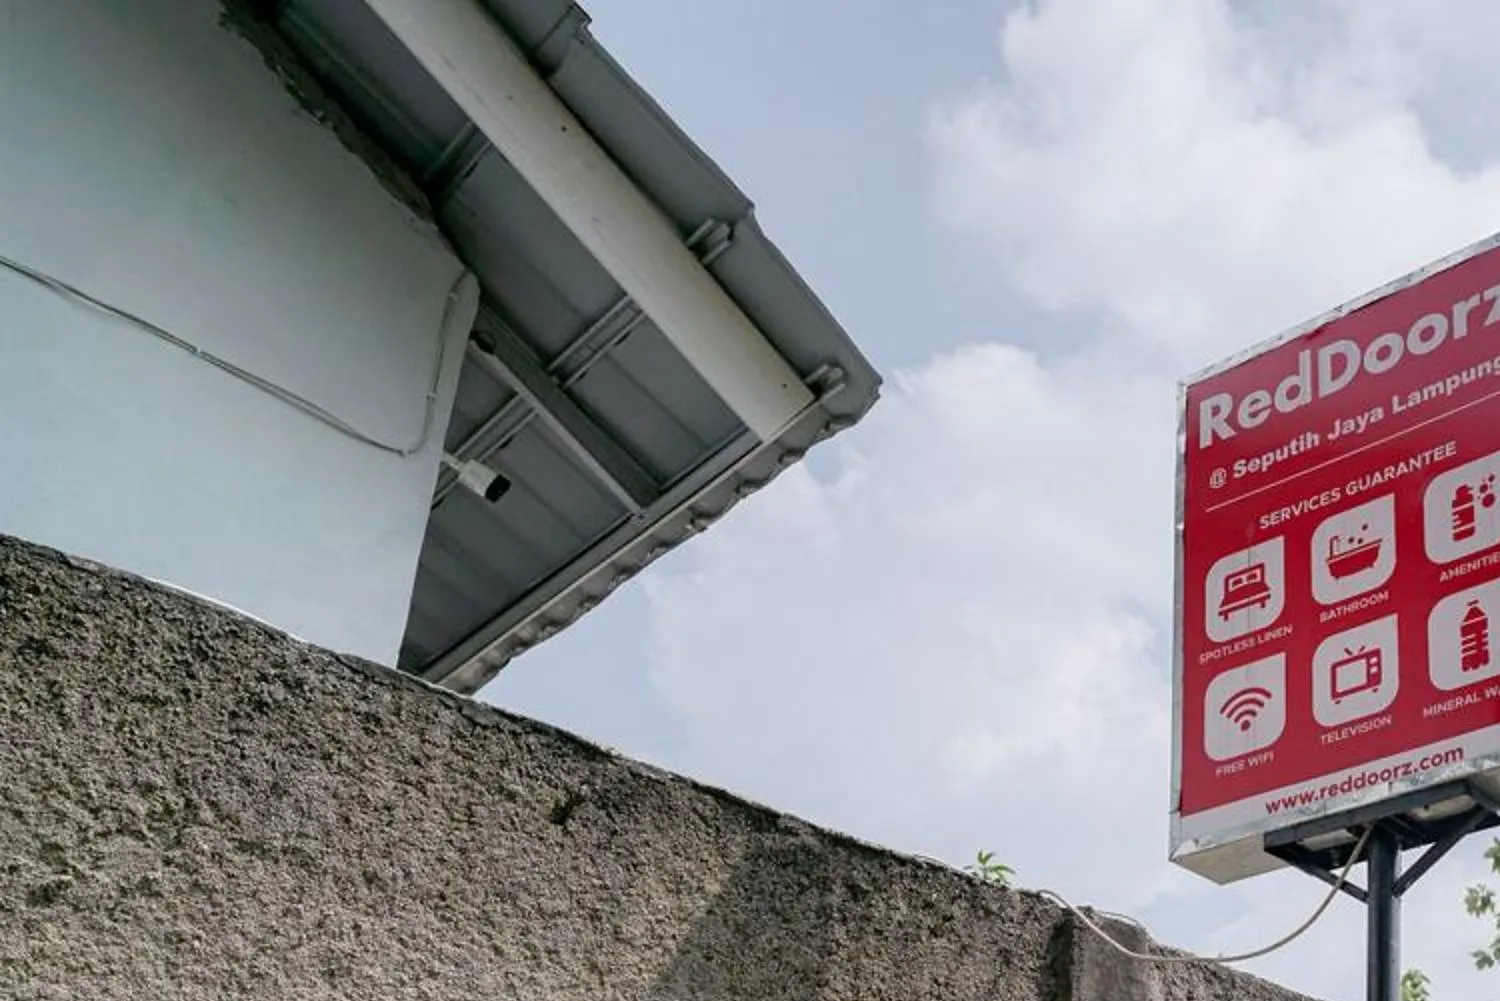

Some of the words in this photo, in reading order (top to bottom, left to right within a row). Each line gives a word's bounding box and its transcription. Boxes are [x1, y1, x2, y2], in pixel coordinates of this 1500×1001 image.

[1209, 467, 1227, 489] @
[1233, 433, 1319, 479] Seputih
[1327, 404, 1385, 441] Jaya
[1259, 487, 1340, 529] SERVICES
[1345, 440, 1457, 497] GUARANTEE
[1319, 591, 1389, 623] BATHROOM
[1199, 634, 1255, 665] SPOTLESS
[1256, 624, 1293, 647] LINEN
[1423, 691, 1482, 719] MINERAL
[1320, 714, 1392, 745] TELEVISION
[1215, 757, 1245, 777] FREE
[1247, 751, 1274, 769] WIFI
[1264, 744, 1464, 815] www.reddoorz.com
